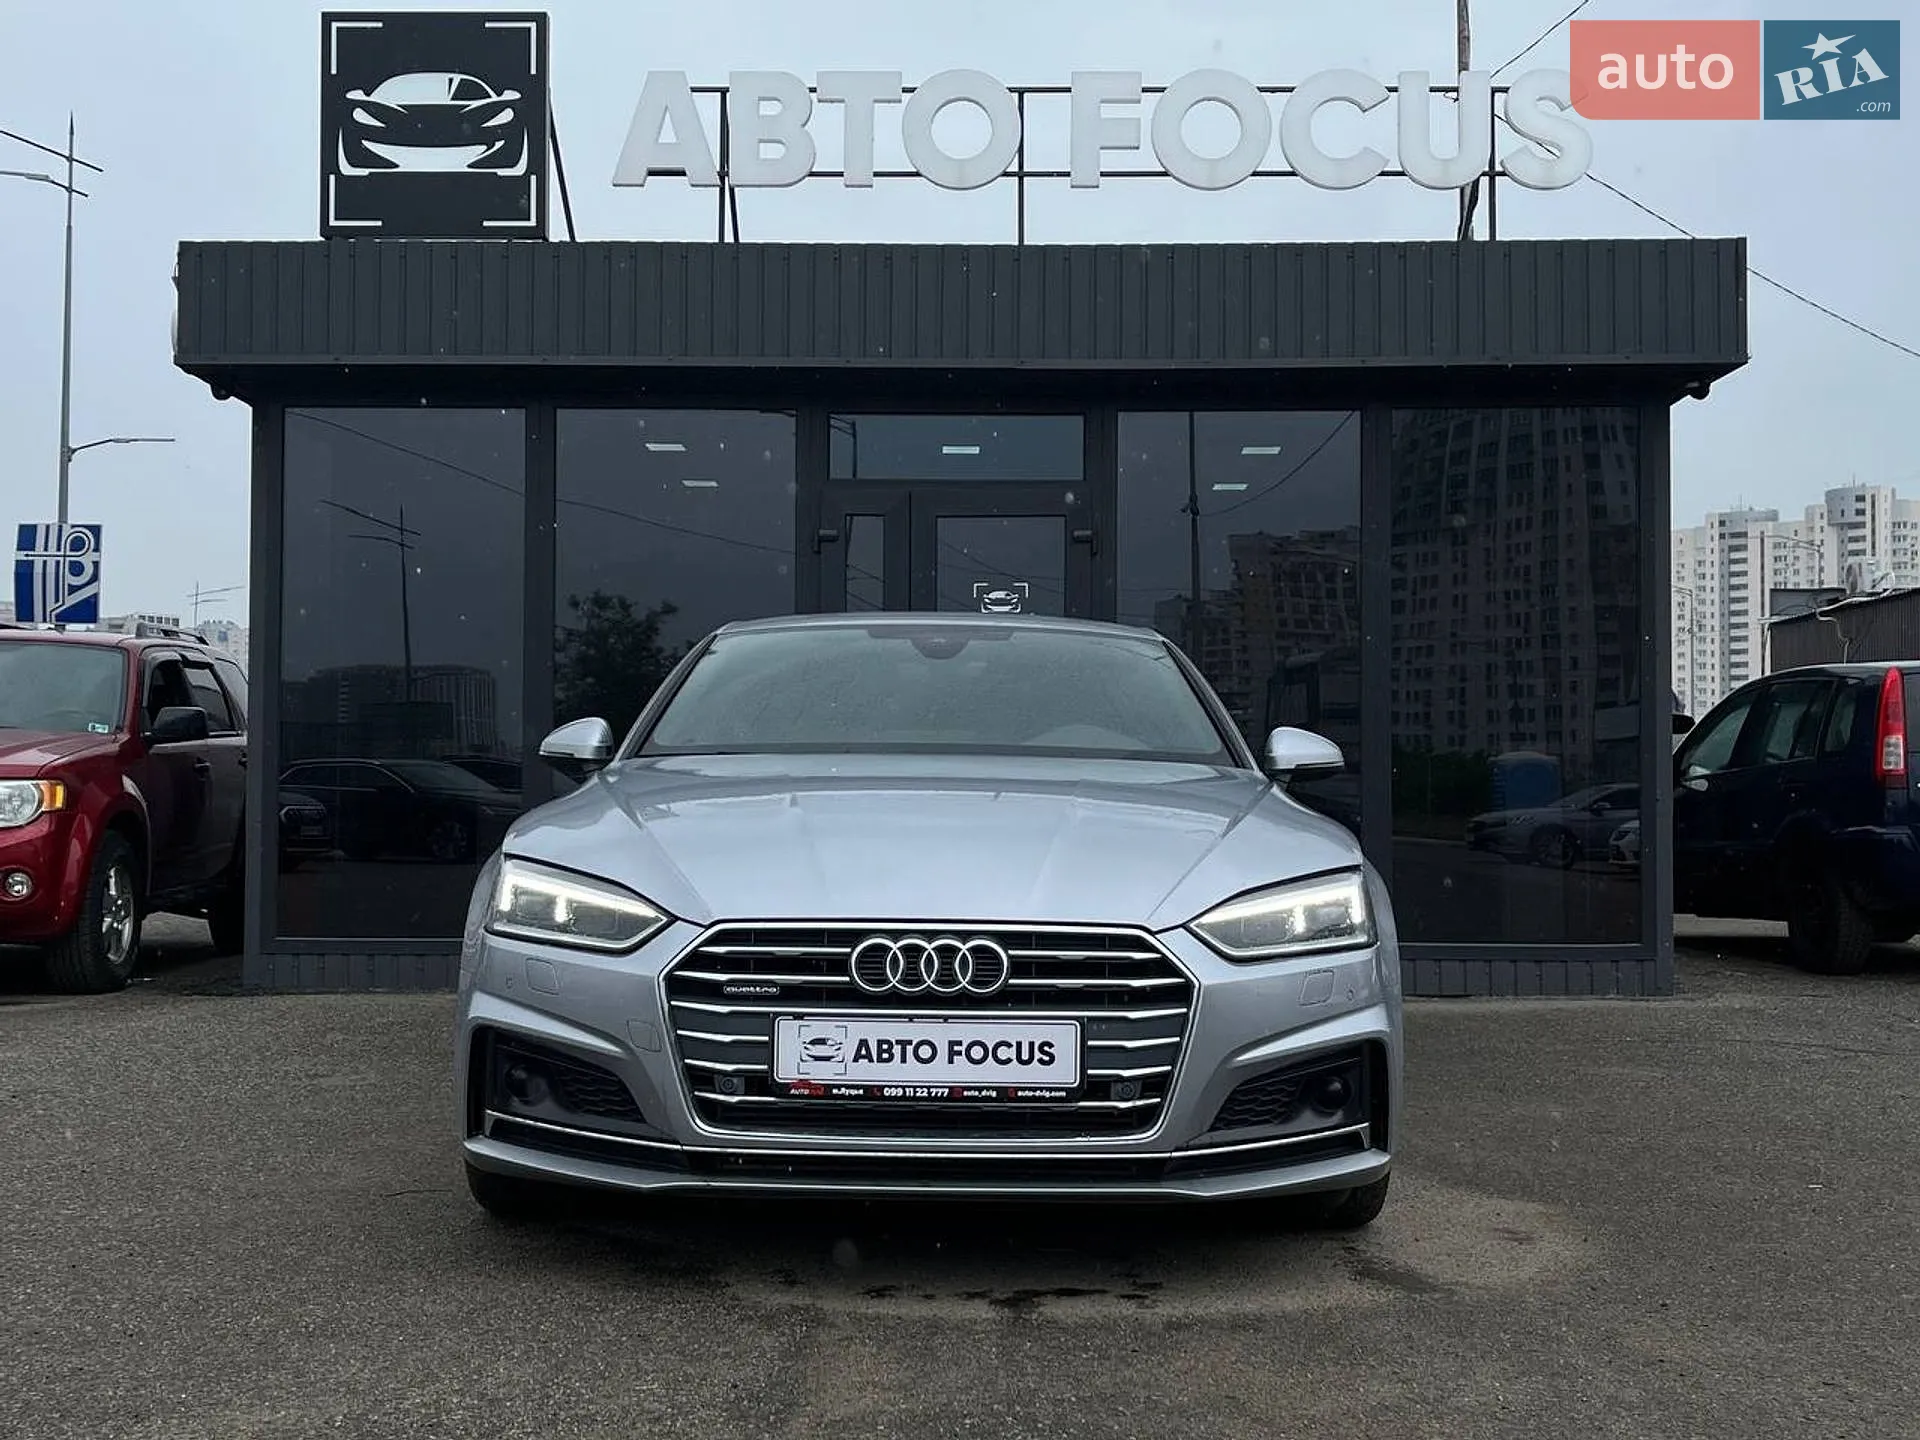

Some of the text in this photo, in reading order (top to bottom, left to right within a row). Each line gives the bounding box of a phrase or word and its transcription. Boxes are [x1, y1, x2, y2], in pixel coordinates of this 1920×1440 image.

[612, 68, 1594, 190] АВТО FOCUS
[947, 1039, 1056, 1066] FOCUS
[883, 1087, 949, 1097] 099 11 22 777
